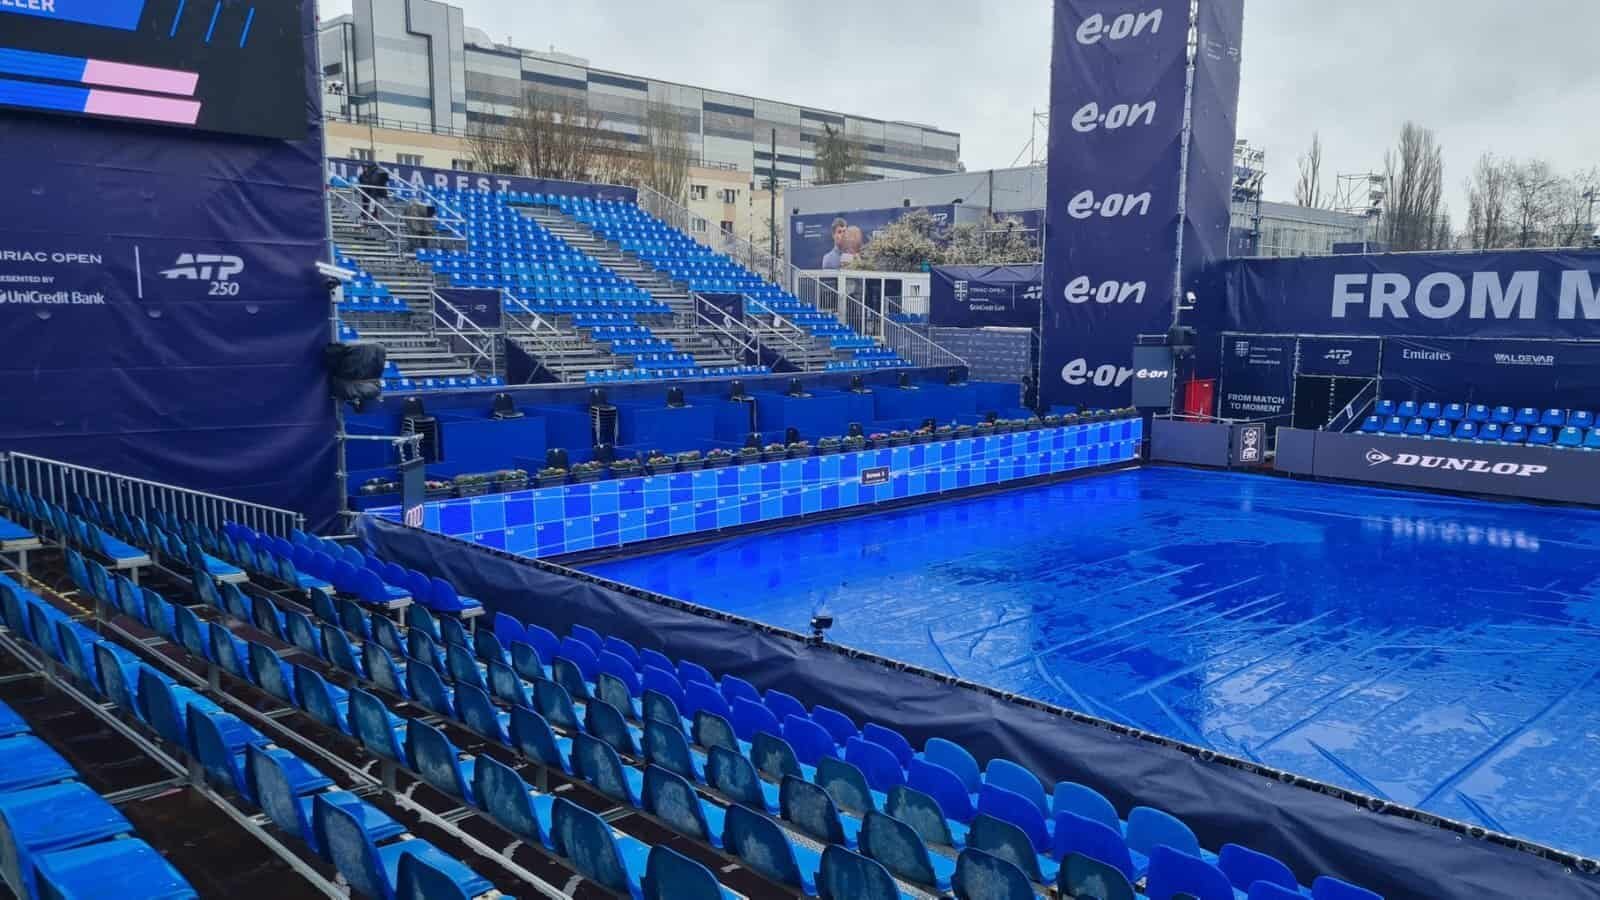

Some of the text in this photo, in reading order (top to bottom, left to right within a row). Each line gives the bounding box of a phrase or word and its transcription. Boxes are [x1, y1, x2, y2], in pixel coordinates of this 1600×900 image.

[51, 252, 102, 264] OPEN
[157, 252, 245, 281] ATP
[42, 276, 55, 284] BY
[207, 280, 241, 297] 250
[1331, 269, 1600, 320] FROM M
[7, 290, 105, 305] UniCredit Bank
[1402, 348, 1451, 361] Emirates
[1227, 393, 1285, 405] FROM MATCH
[1231, 402, 1282, 413] TO MOMENT
[1392, 452, 1548, 477] DUNLOP
